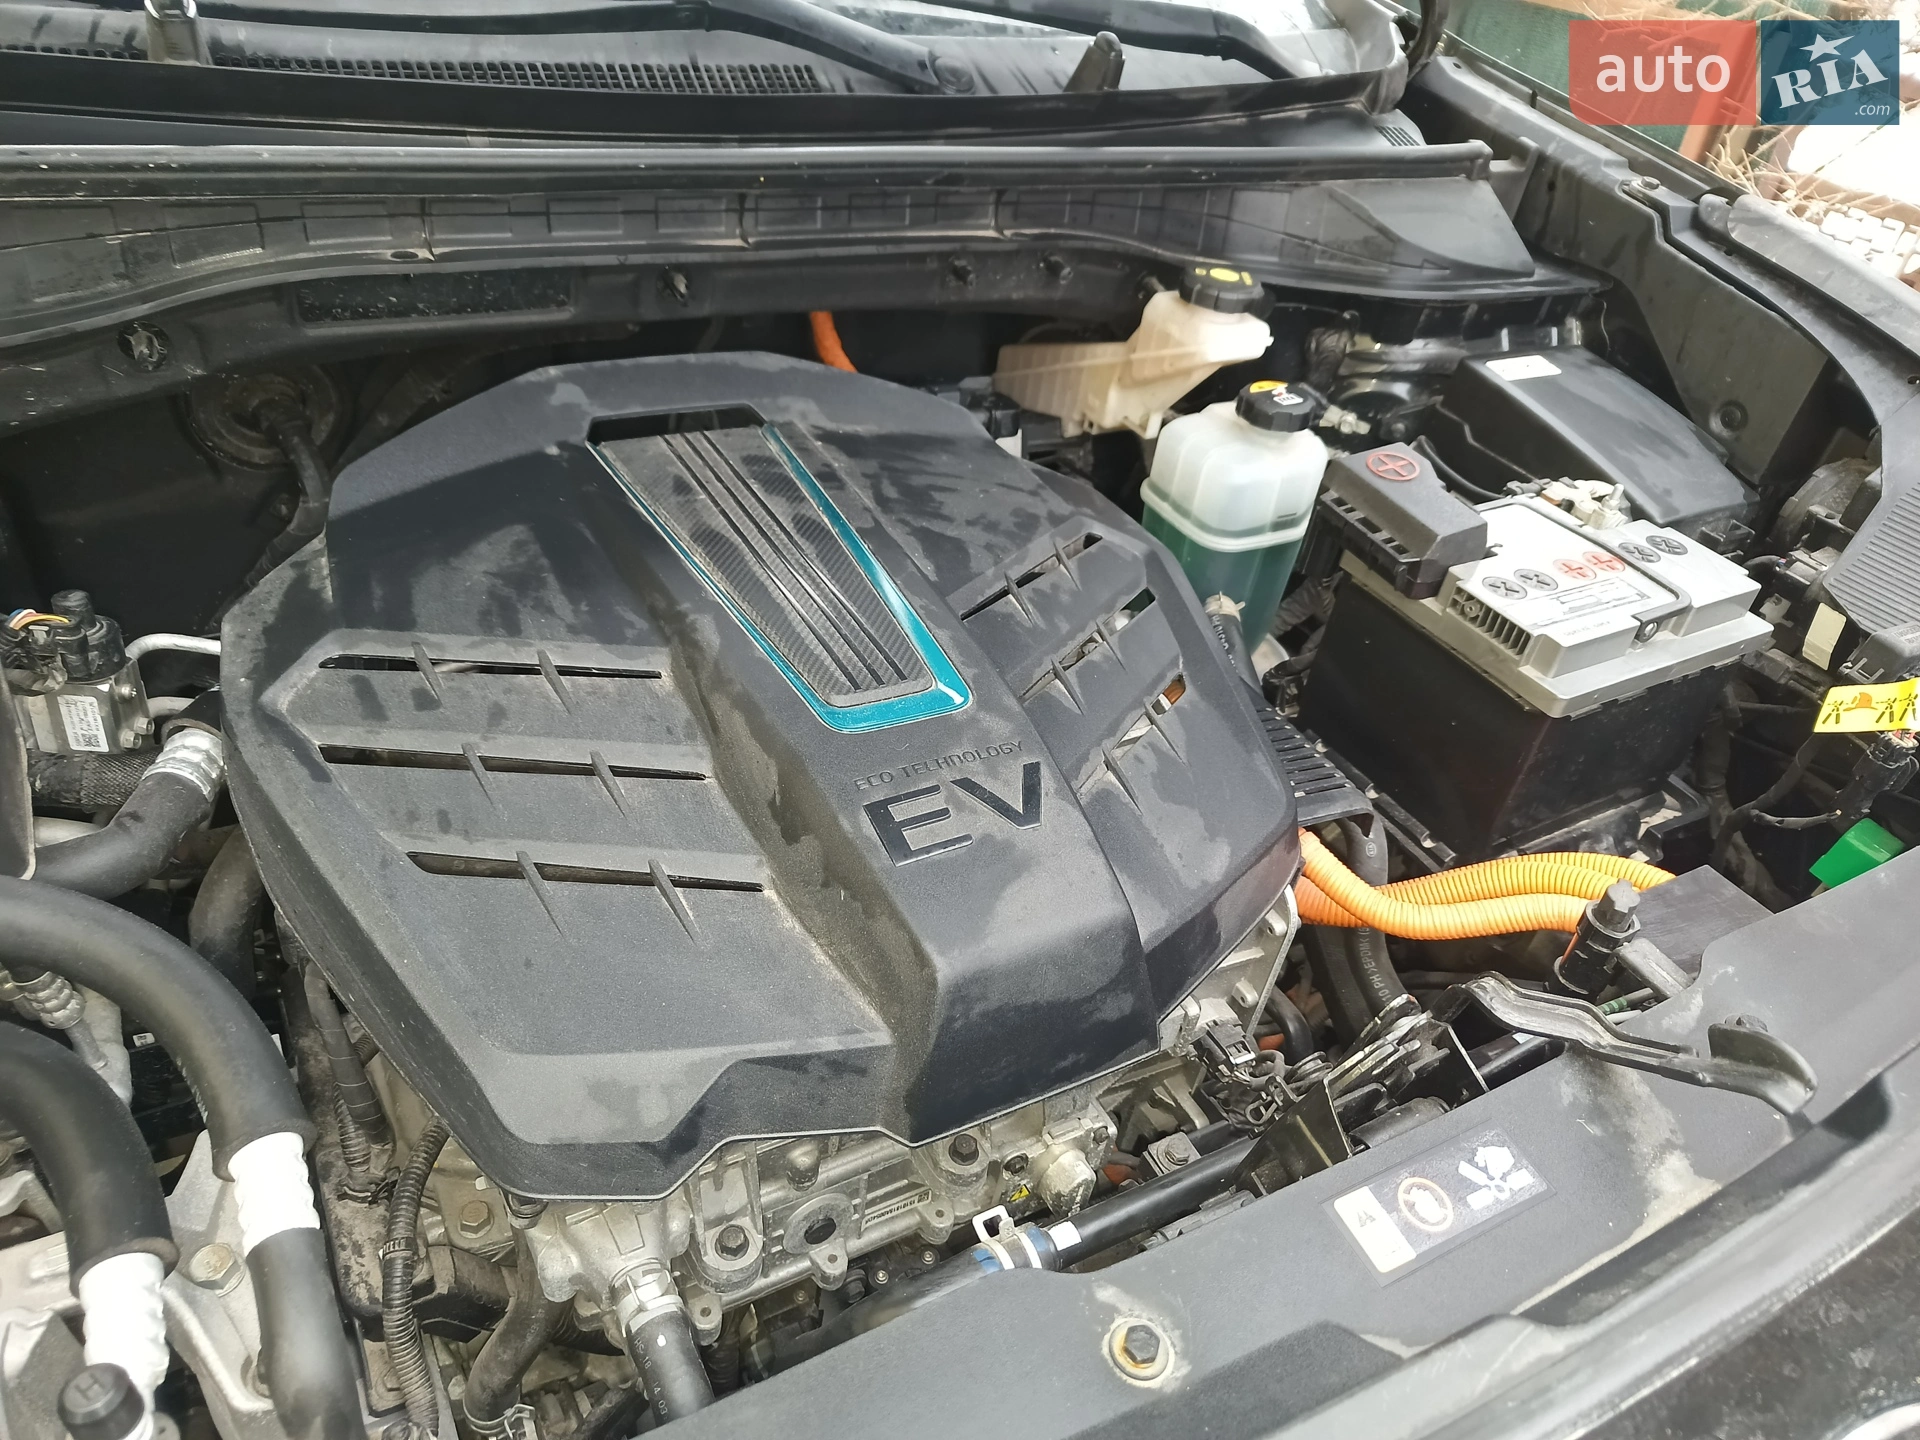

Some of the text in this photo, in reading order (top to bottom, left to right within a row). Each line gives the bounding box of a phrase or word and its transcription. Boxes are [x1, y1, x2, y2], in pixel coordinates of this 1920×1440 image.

[853, 740, 1024, 791] ECO TECHNOLOGY
[862, 760, 1042, 867] EV
